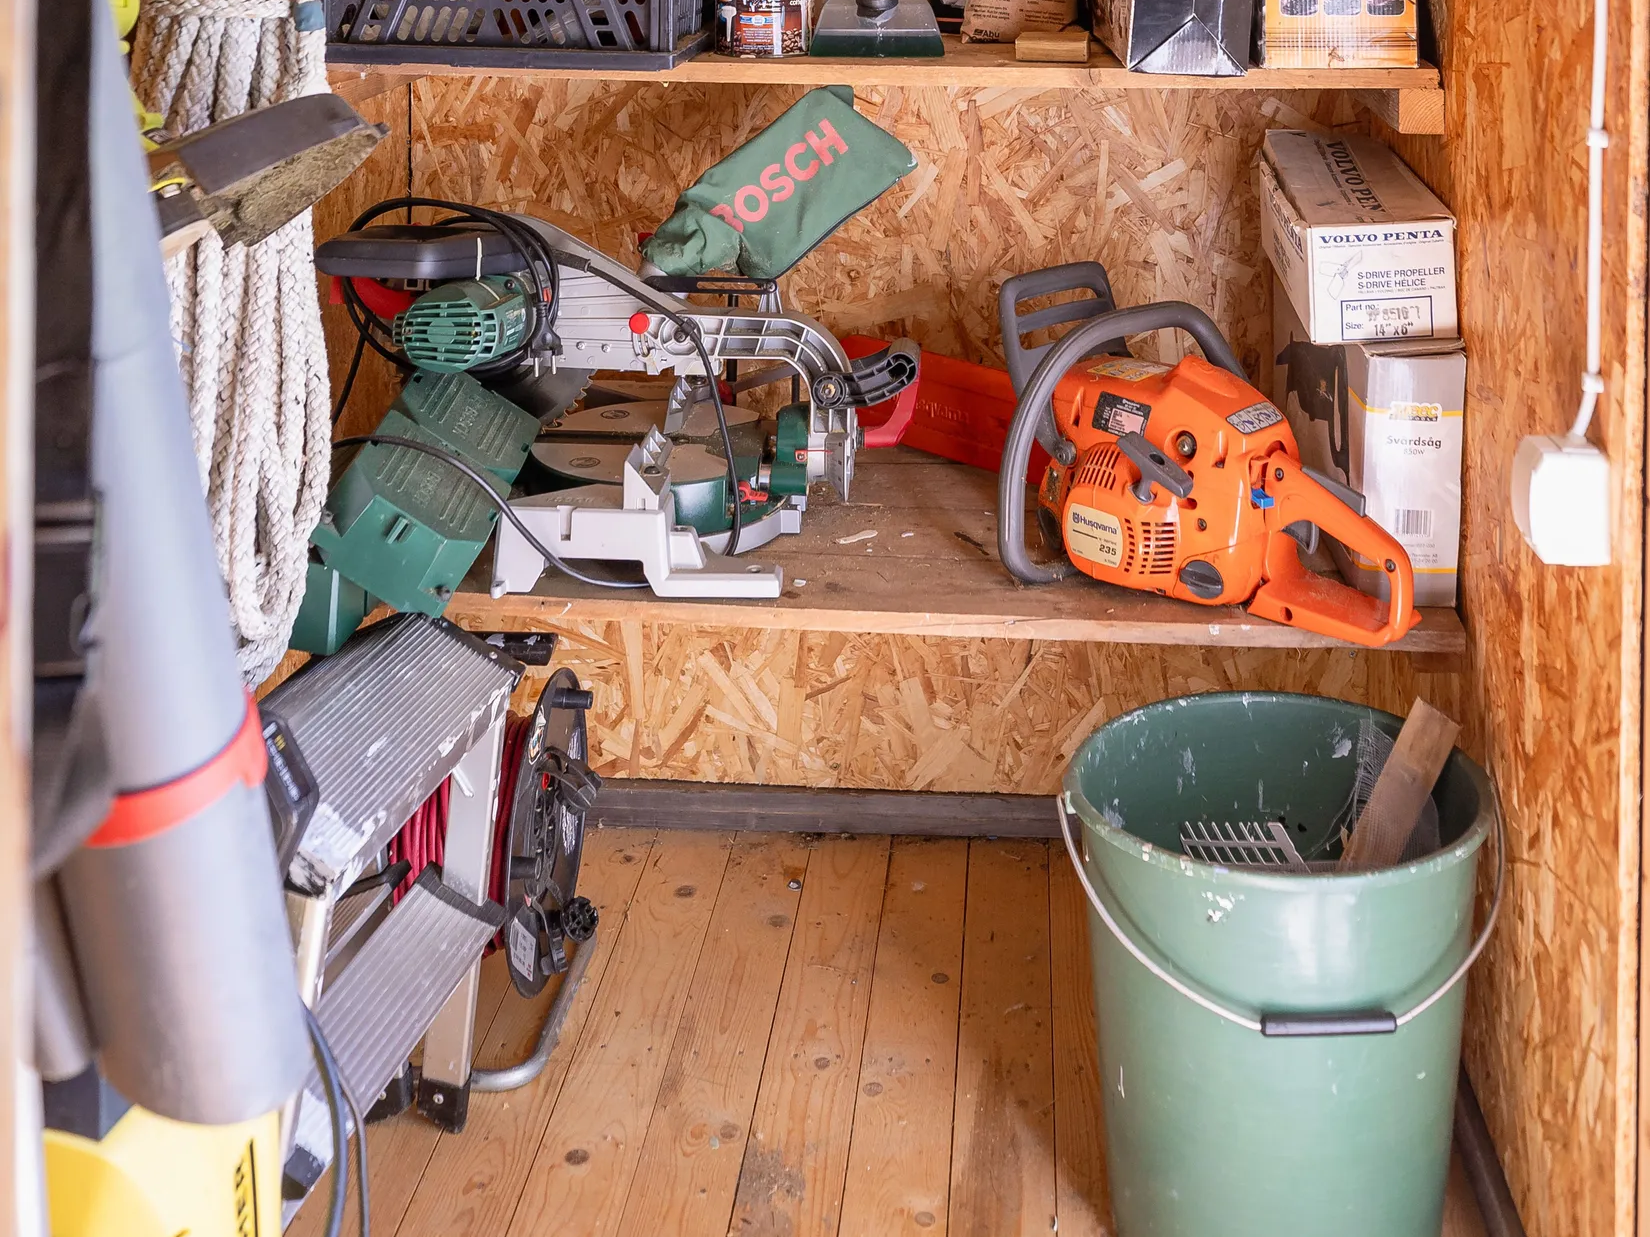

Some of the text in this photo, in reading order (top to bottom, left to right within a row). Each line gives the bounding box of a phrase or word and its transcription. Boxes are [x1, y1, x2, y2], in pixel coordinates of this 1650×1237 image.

[1326, 140, 1364, 186] VOLVO
[1319, 229, 1444, 244] VOLVO PENTA
[1357, 266, 1445, 280] S-DRIVE PROPELLER
[1357, 280, 1392, 290] S-DRIVE
[1345, 303, 1363, 311] Part
[1345, 322, 1364, 330] Size:
[1080, 515, 1118, 535] Husqvarna
[1099, 544, 1117, 556] 235
